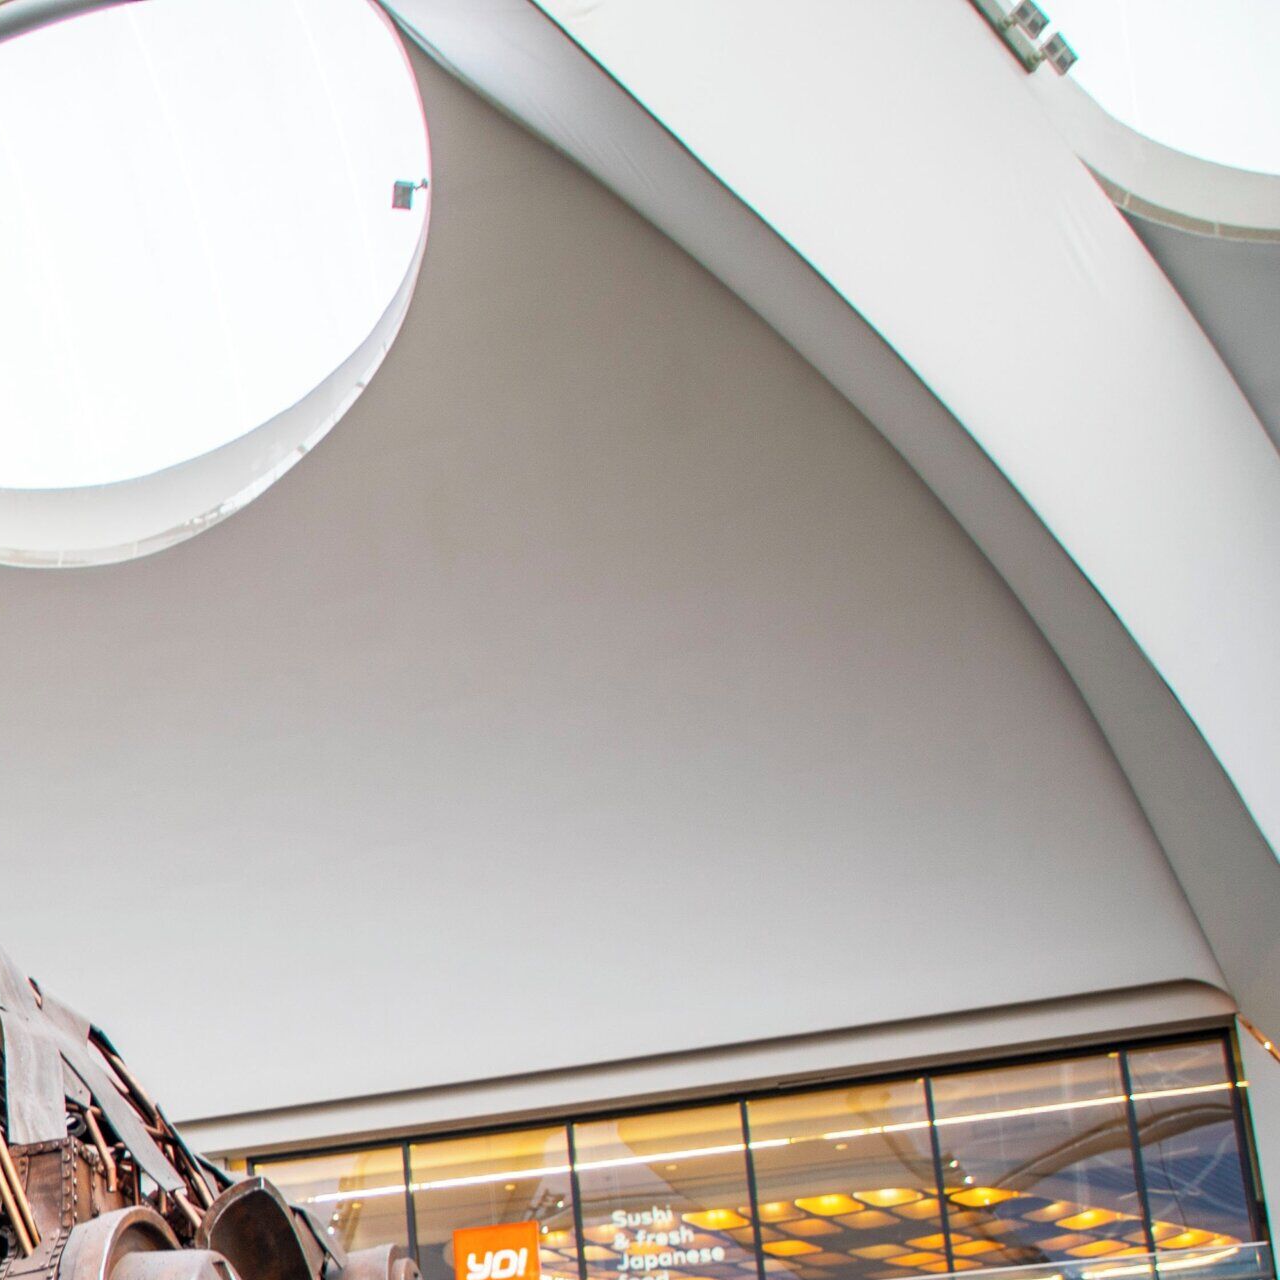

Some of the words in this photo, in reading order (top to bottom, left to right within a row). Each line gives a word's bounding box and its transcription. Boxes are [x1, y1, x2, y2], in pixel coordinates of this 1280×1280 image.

[611, 1205, 673, 1228] Sushi
[613, 1233, 629, 1250] &
[636, 1226, 695, 1246] fresh
[617, 1246, 725, 1271] Japanese
